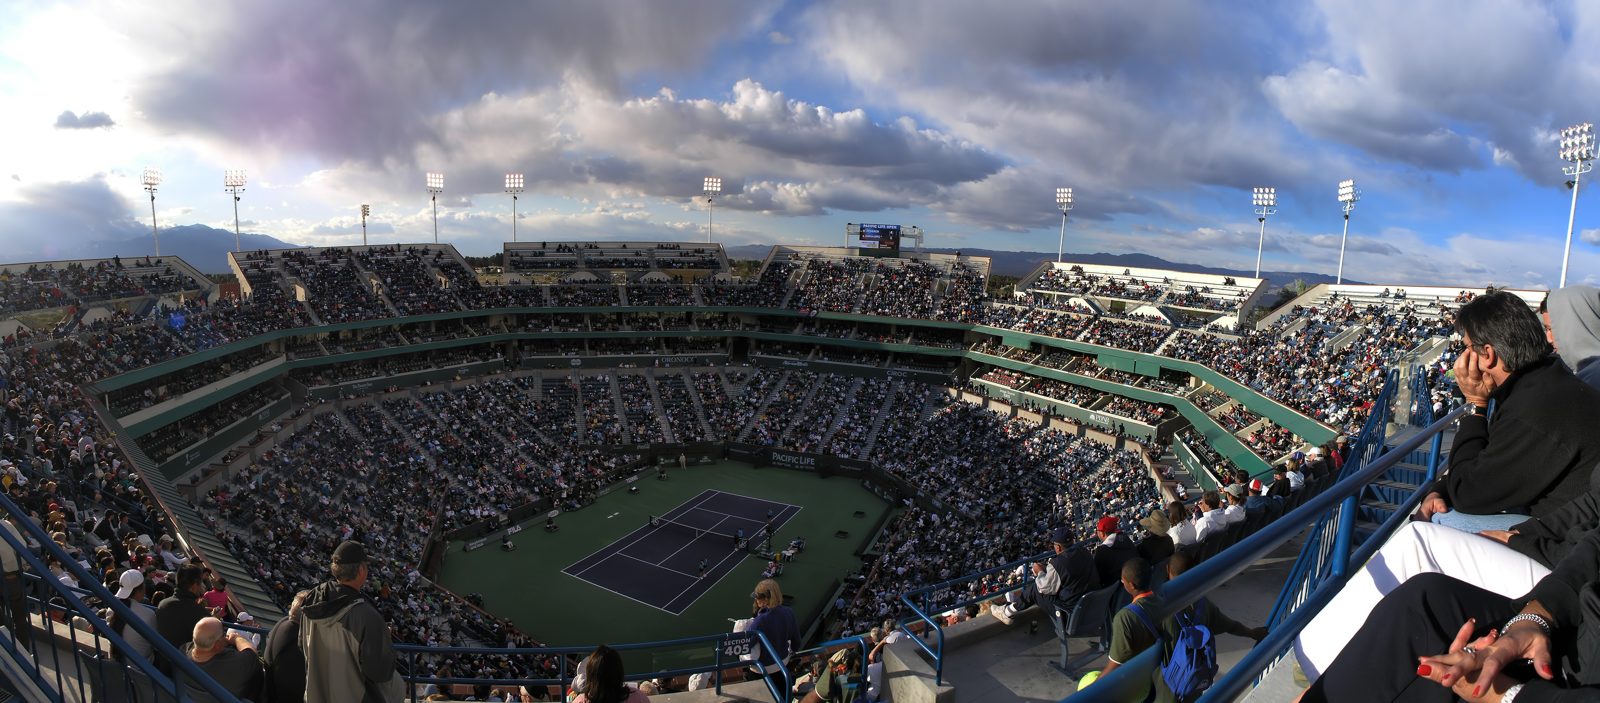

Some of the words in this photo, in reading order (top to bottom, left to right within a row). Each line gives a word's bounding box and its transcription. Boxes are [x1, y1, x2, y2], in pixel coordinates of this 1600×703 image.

[772, 452, 799, 464] PACIFIC
[800, 456, 815, 465] LIFE
[507, 524, 522, 535] FILA
[932, 591, 949, 602] 404
[723, 638, 751, 646] SECTION
[724, 644, 750, 656] 405
